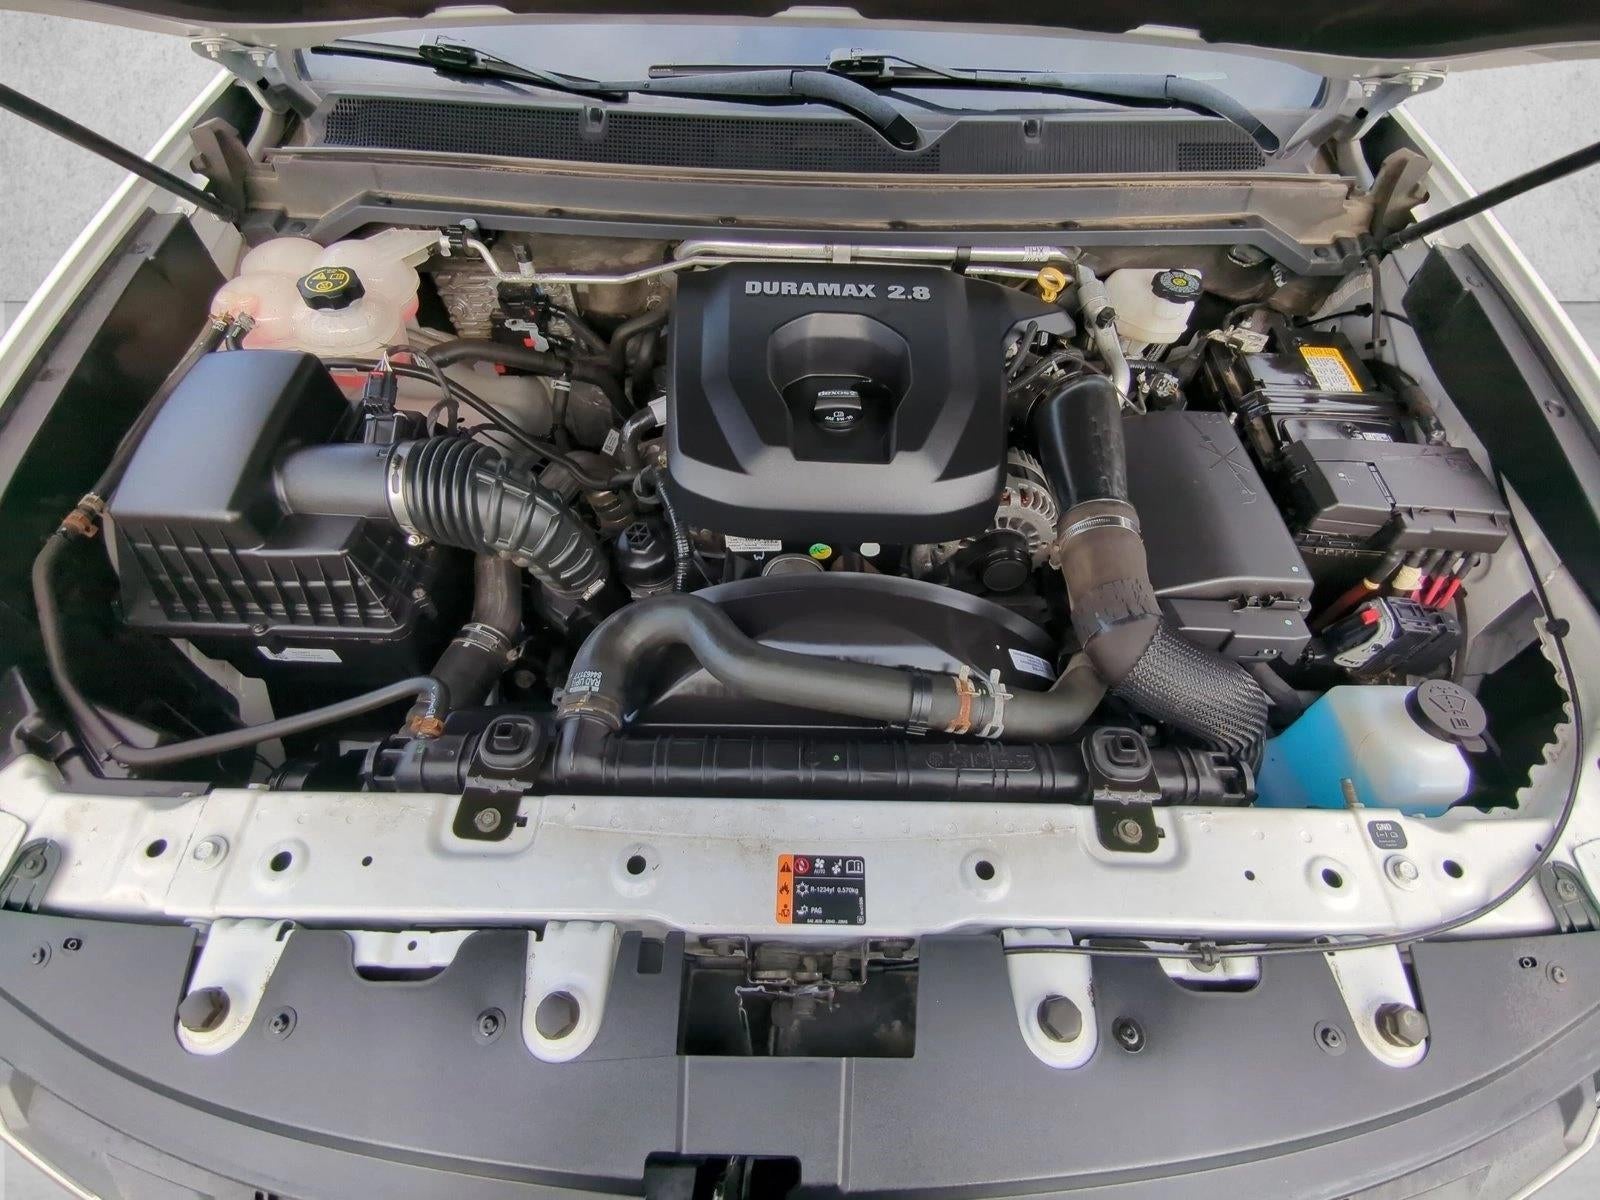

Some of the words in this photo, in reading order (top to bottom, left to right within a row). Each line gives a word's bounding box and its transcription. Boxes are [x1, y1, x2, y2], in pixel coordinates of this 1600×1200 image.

[745, 281, 876, 298] DURAMAX
[887, 285, 931, 300] 2.8
[810, 886, 834, 894] R-1234yf
[837, 886, 858, 895] 0.570kg
